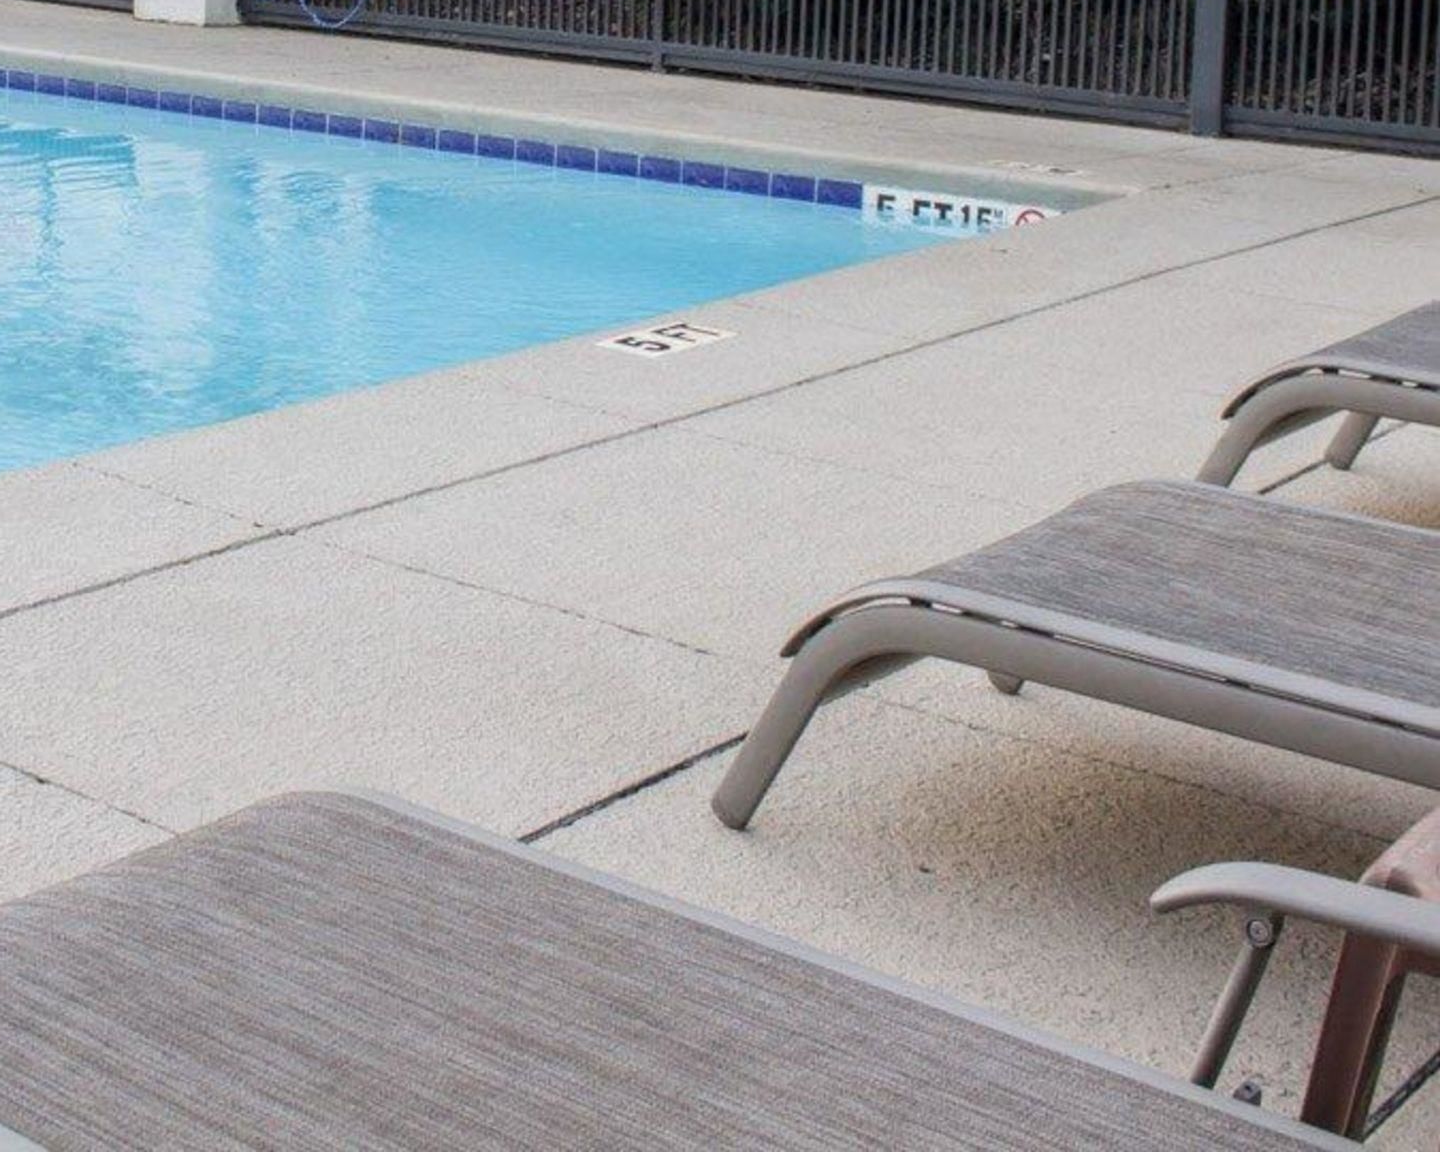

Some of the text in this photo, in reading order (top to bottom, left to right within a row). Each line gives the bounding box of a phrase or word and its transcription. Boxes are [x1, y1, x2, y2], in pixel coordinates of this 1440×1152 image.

[912, 199, 954, 221] FT
[613, 323, 720, 352] 5 FT
